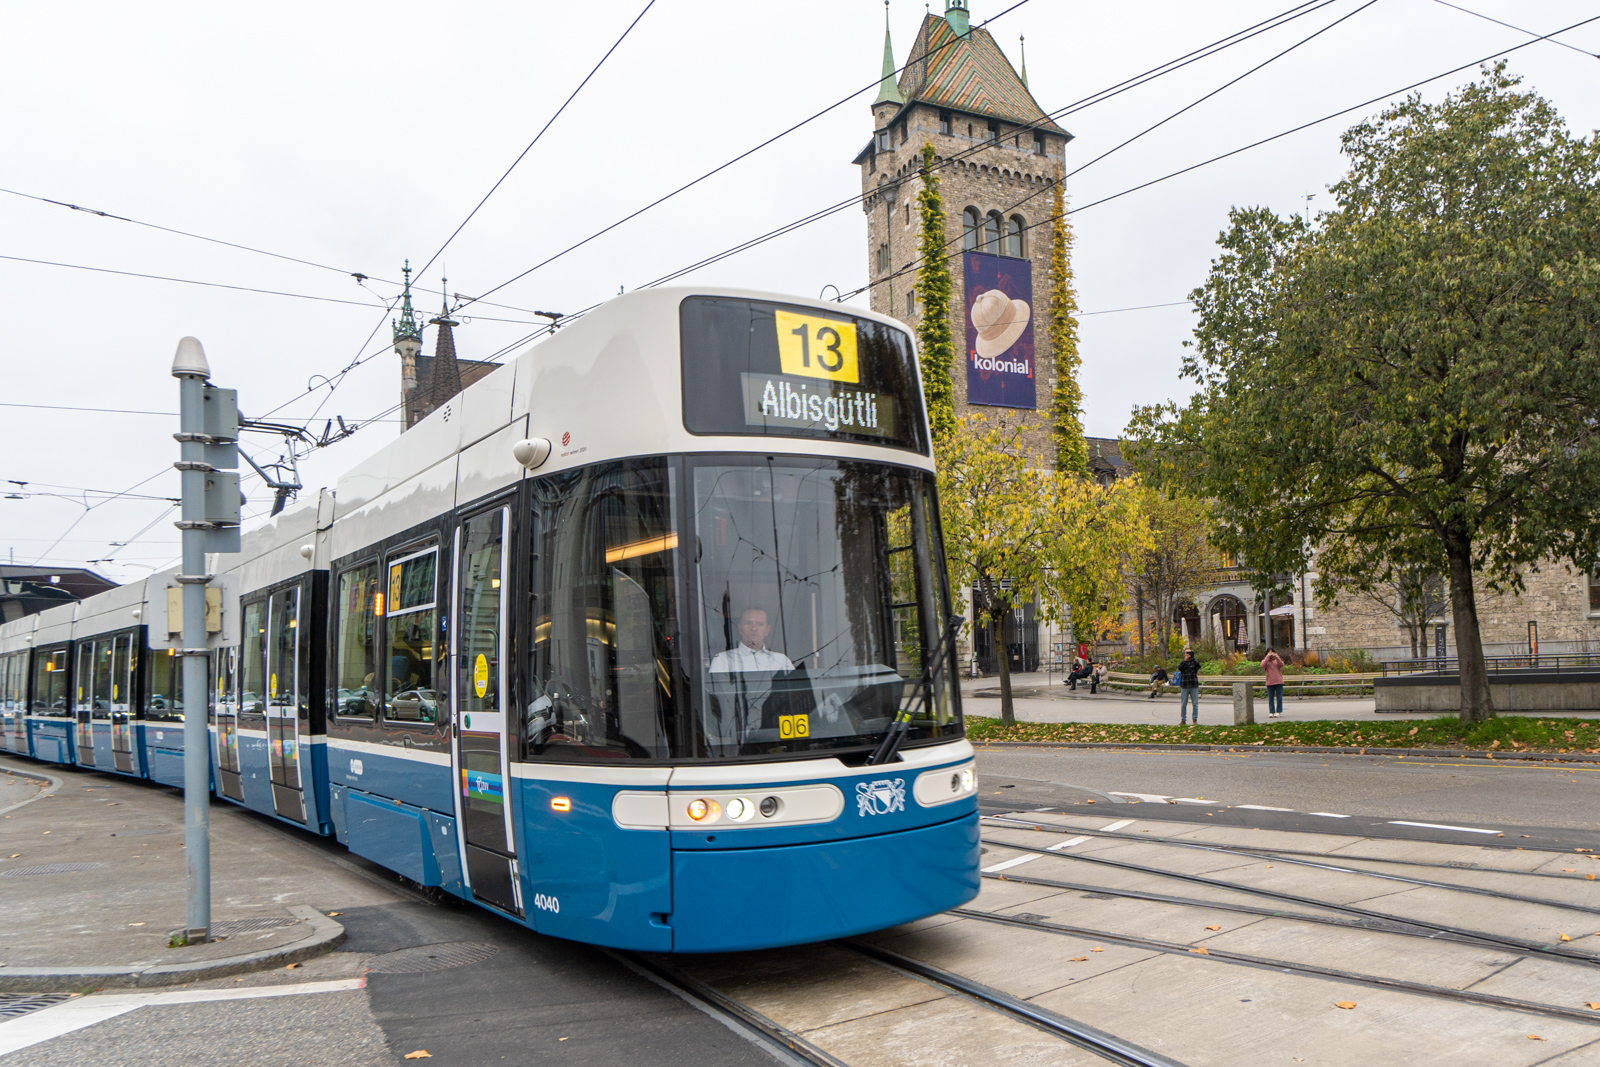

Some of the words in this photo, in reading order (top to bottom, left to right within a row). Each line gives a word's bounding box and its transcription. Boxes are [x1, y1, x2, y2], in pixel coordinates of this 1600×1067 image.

[792, 323, 843, 372] 13
[974, 353, 1029, 375] kolonial
[762, 380, 878, 432] Albisgütli
[392, 574, 400, 602] 13
[782, 718, 806, 736] 06
[534, 893, 560, 915] 4040
